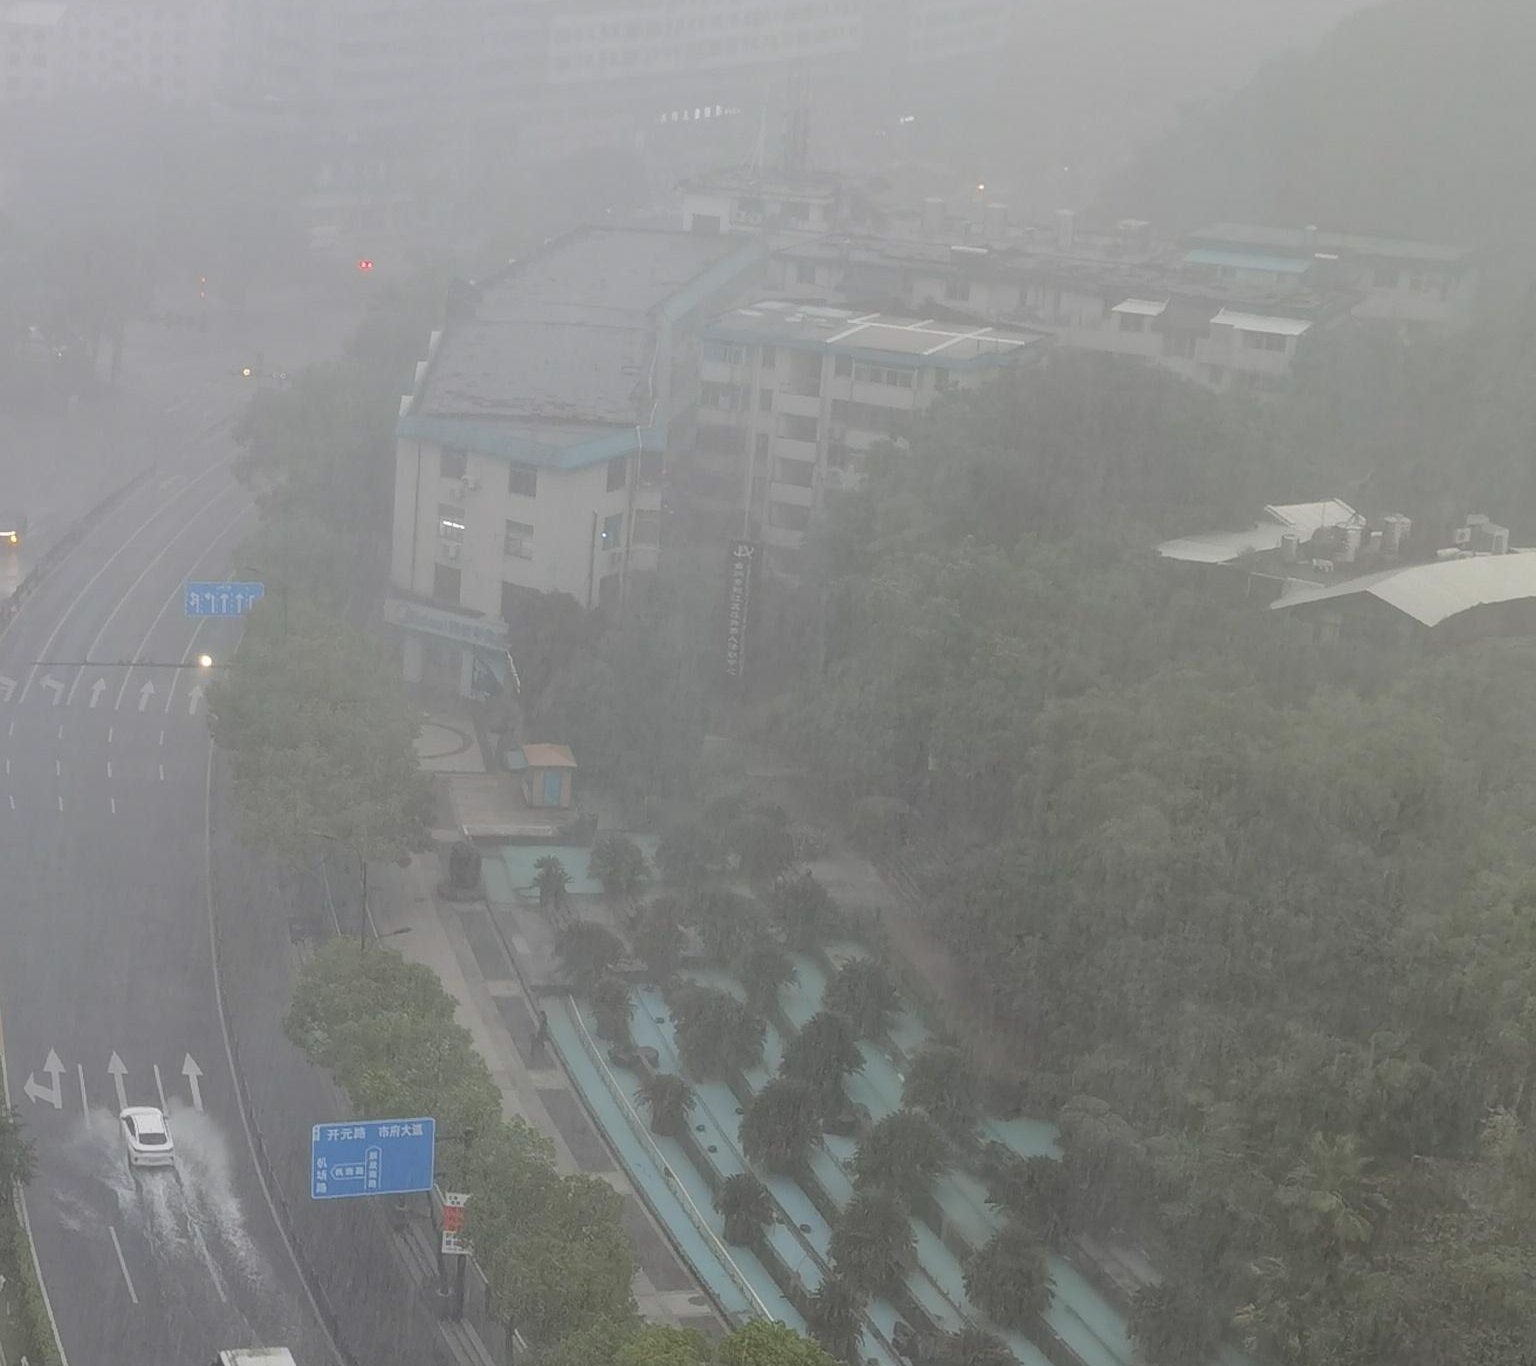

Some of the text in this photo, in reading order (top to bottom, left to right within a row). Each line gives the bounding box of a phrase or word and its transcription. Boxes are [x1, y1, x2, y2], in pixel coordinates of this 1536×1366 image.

[327, 1127, 366, 1142] 开元路
[378, 1123, 423, 1138] 市府大道
[316, 1157, 328, 1193] 机场路
